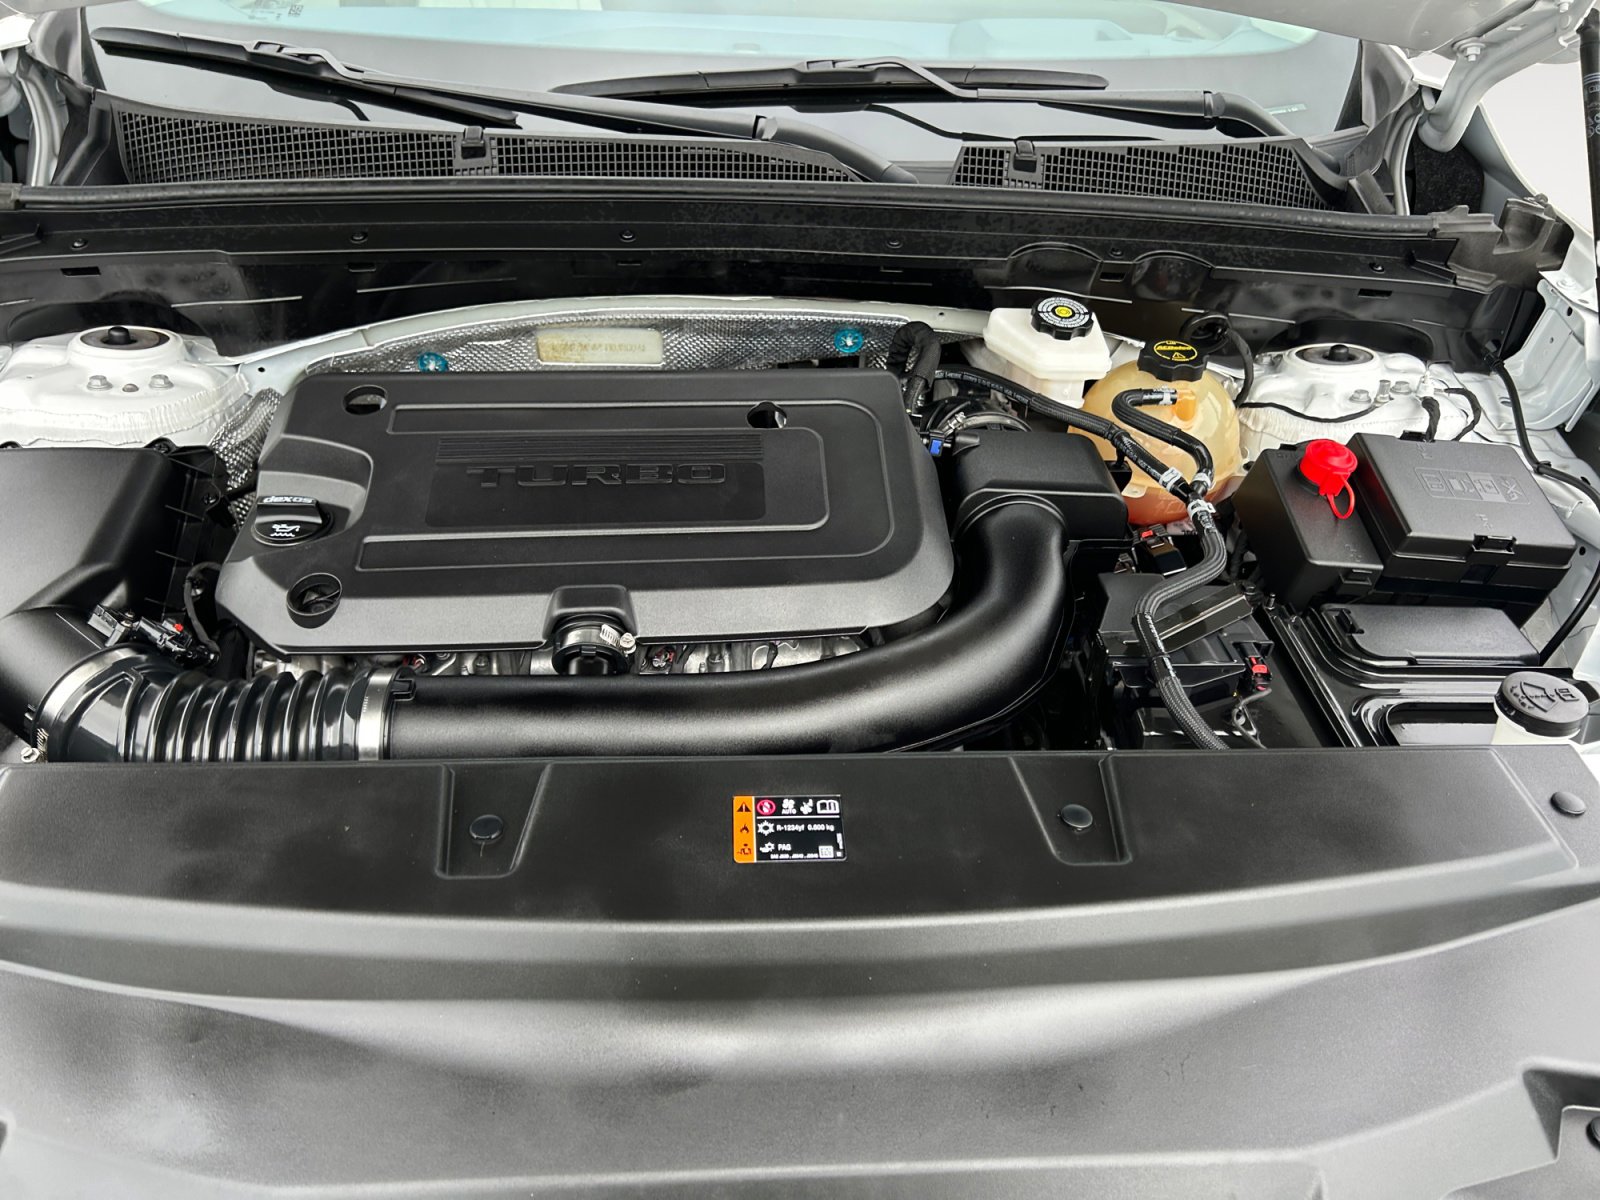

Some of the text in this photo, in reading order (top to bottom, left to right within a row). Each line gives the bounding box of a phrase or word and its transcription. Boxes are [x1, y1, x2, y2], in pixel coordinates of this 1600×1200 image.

[466, 463, 726, 488] TURBO
[263, 496, 313, 504] dexos
[776, 824, 805, 832] R-1234yf
[826, 824, 834, 832] kg
[777, 843, 791, 851] PAG
